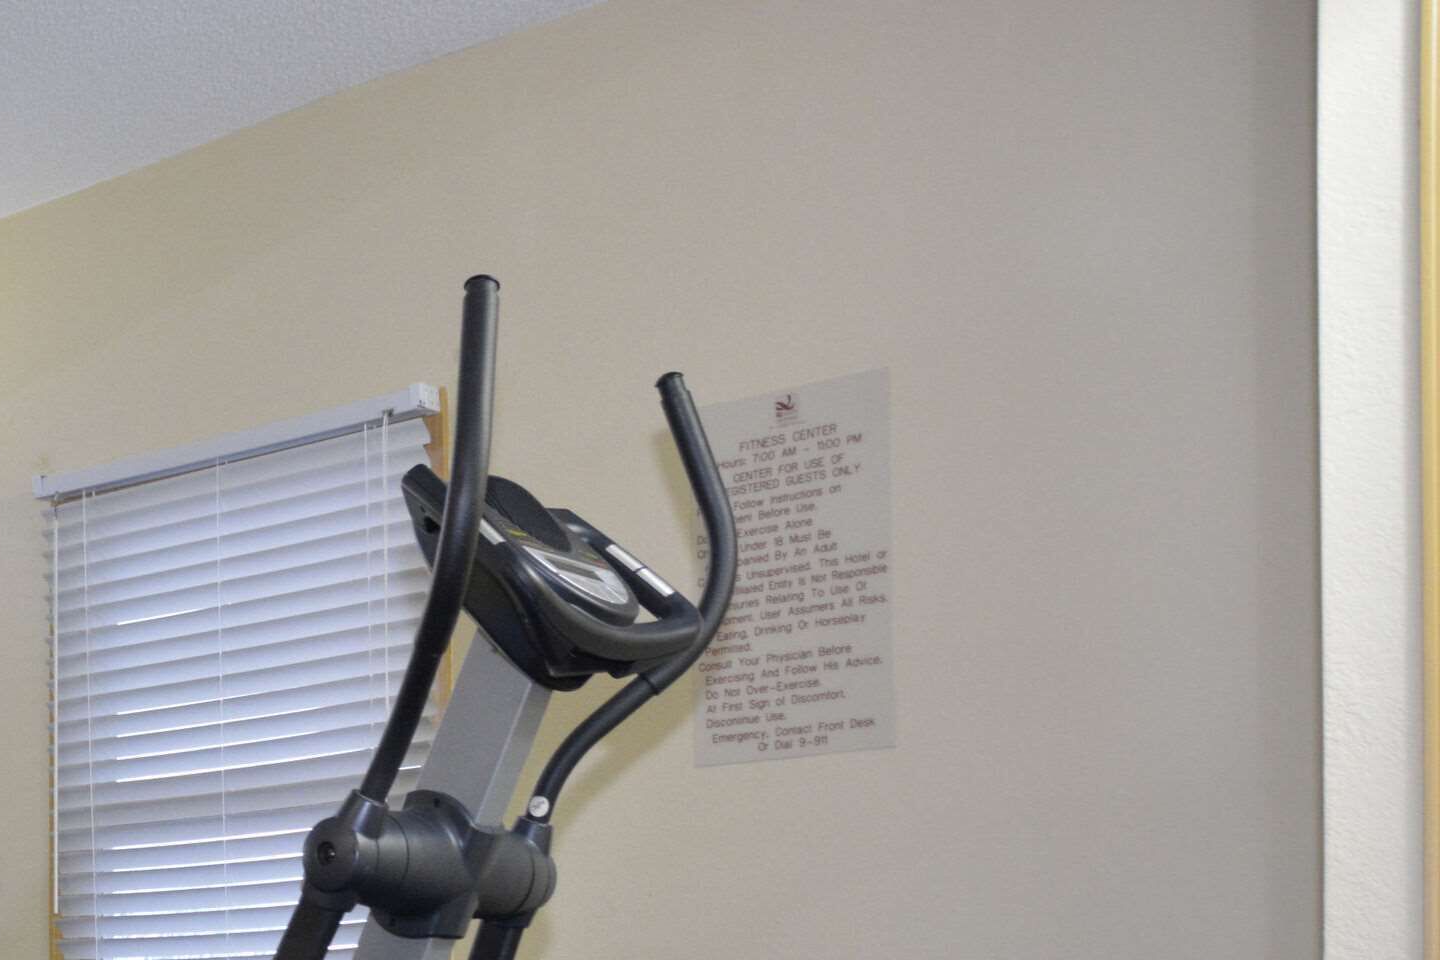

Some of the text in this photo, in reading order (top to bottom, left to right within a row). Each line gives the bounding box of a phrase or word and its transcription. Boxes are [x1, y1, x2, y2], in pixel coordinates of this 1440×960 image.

[739, 424, 837, 451] FITNESS CENTER
[753, 451, 775, 463] 7:00
[782, 447, 796, 456] AM
[846, 433, 862, 445] PM
[733, 453, 844, 483] CENTER FOR USE OF
[785, 470, 826, 486] GUESTS
[831, 464, 860, 477] ONLY
[734, 500, 763, 511] Follow
[828, 485, 842, 494] on
[758, 506, 790, 520] Before
[739, 541, 767, 552] Under
[789, 533, 810, 544] Must
[817, 530, 832, 540] Be
[775, 551, 788, 561] By
[794, 547, 806, 556] An
[820, 558, 839, 567] This
[844, 552, 870, 564] Hotel
[768, 580, 793, 592] Entity
[811, 573, 827, 583] Not
[831, 564, 887, 580] Responsible
[766, 591, 804, 605] Relating
[811, 588, 825, 598] To
[830, 585, 849, 595] Use
[760, 609, 781, 620] User
[841, 599, 853, 608] All
[754, 623, 792, 638] Drinking
[798, 620, 808, 630] Or
[698, 644, 853, 674] Consult Your Physician Before
[705, 672, 755, 687] Exercising
[761, 668, 780, 678] And
[784, 663, 818, 676] Follow
[823, 661, 839, 671] His
[705, 690, 719, 700] Do
[724, 687, 740, 698] Not
[706, 704, 717, 713] At
[722, 702, 743, 712] First
[749, 699, 771, 711] Sign
[705, 714, 761, 729] Discontinue
[775, 725, 812, 737] Contact
[817, 720, 845, 732] Front
[849, 717, 876, 729] Desk
[757, 742, 768, 752] Or
[774, 739, 793, 751] Dial
